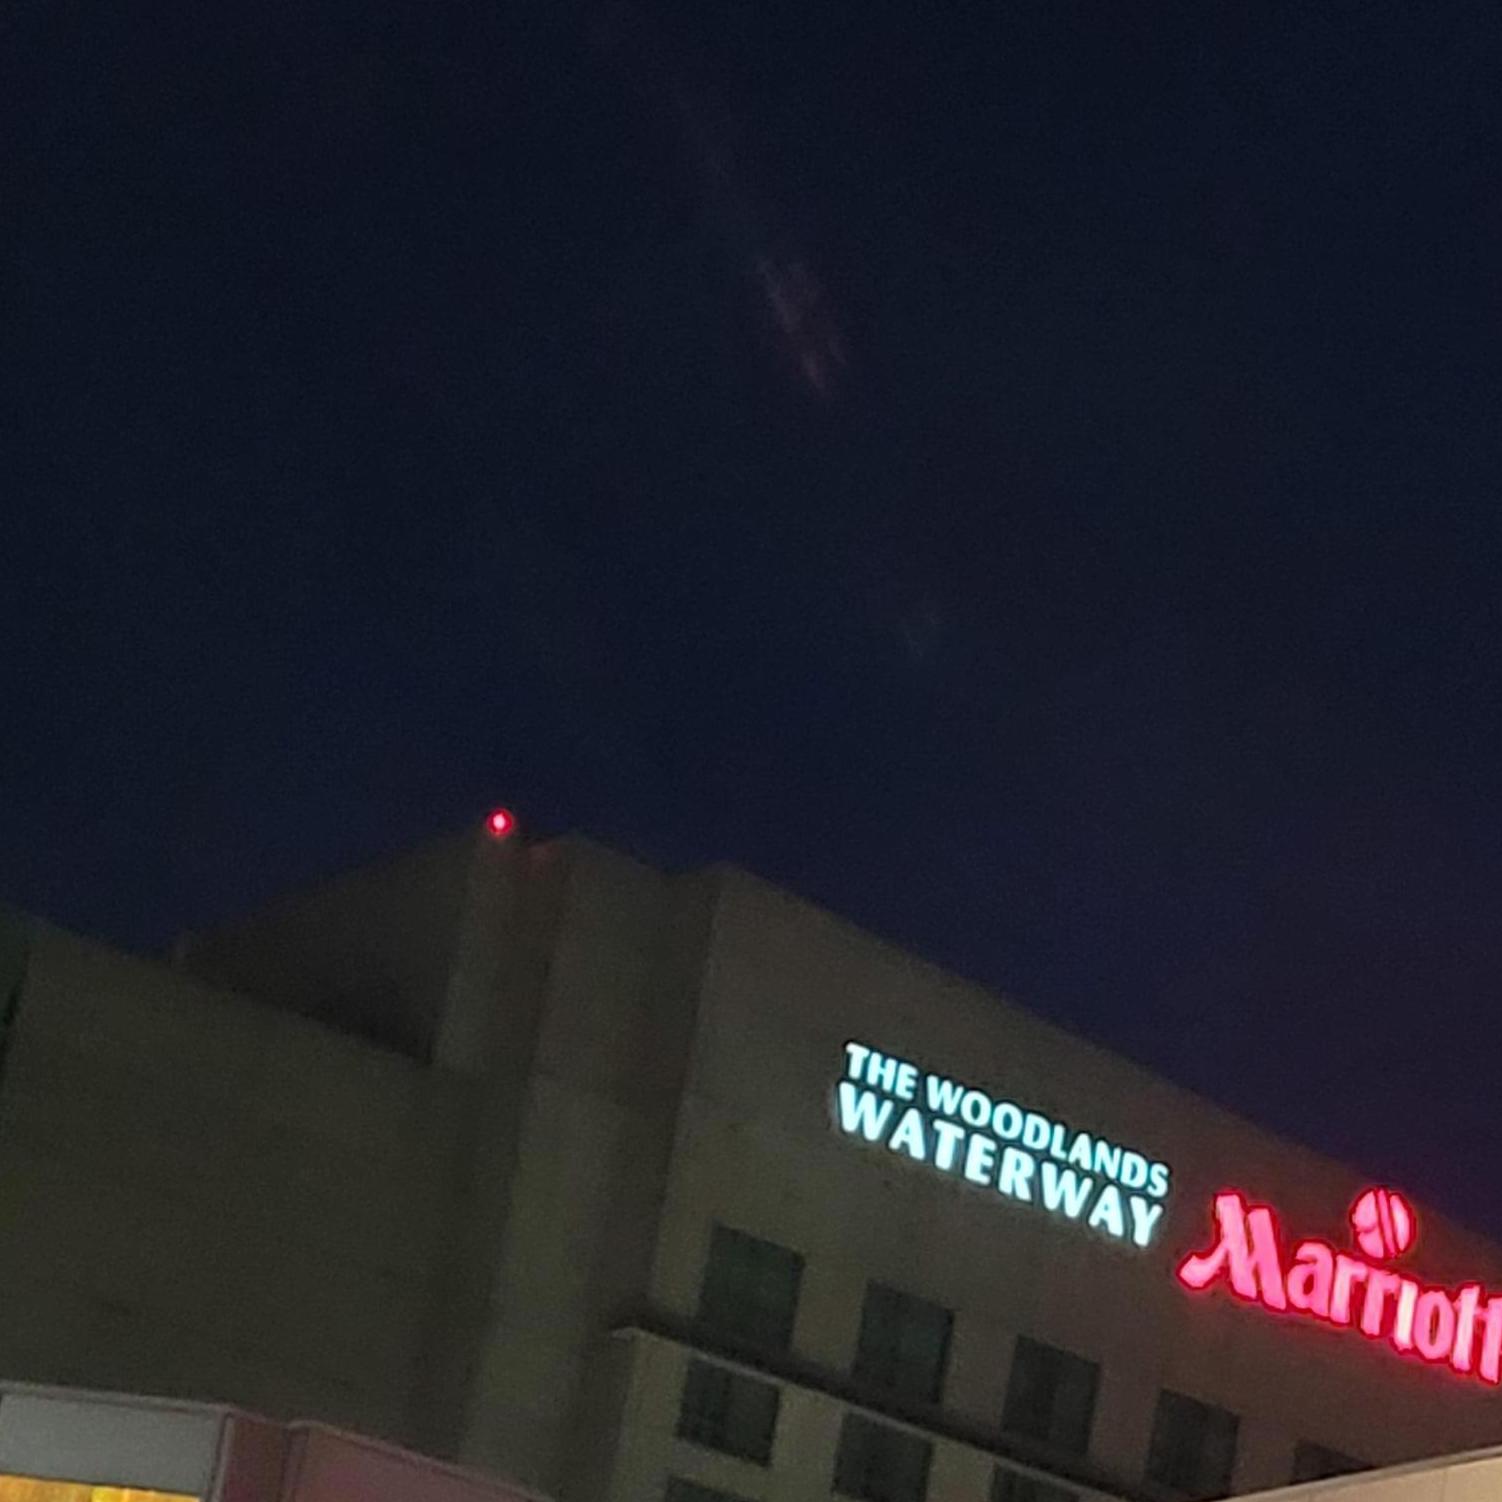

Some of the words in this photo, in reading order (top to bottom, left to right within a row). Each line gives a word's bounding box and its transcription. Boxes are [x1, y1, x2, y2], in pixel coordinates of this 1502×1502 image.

[837, 1082, 1164, 1248] WATERWAY
[845, 1042, 918, 1100] THE
[925, 1073, 1171, 1198] WOODLANDS
